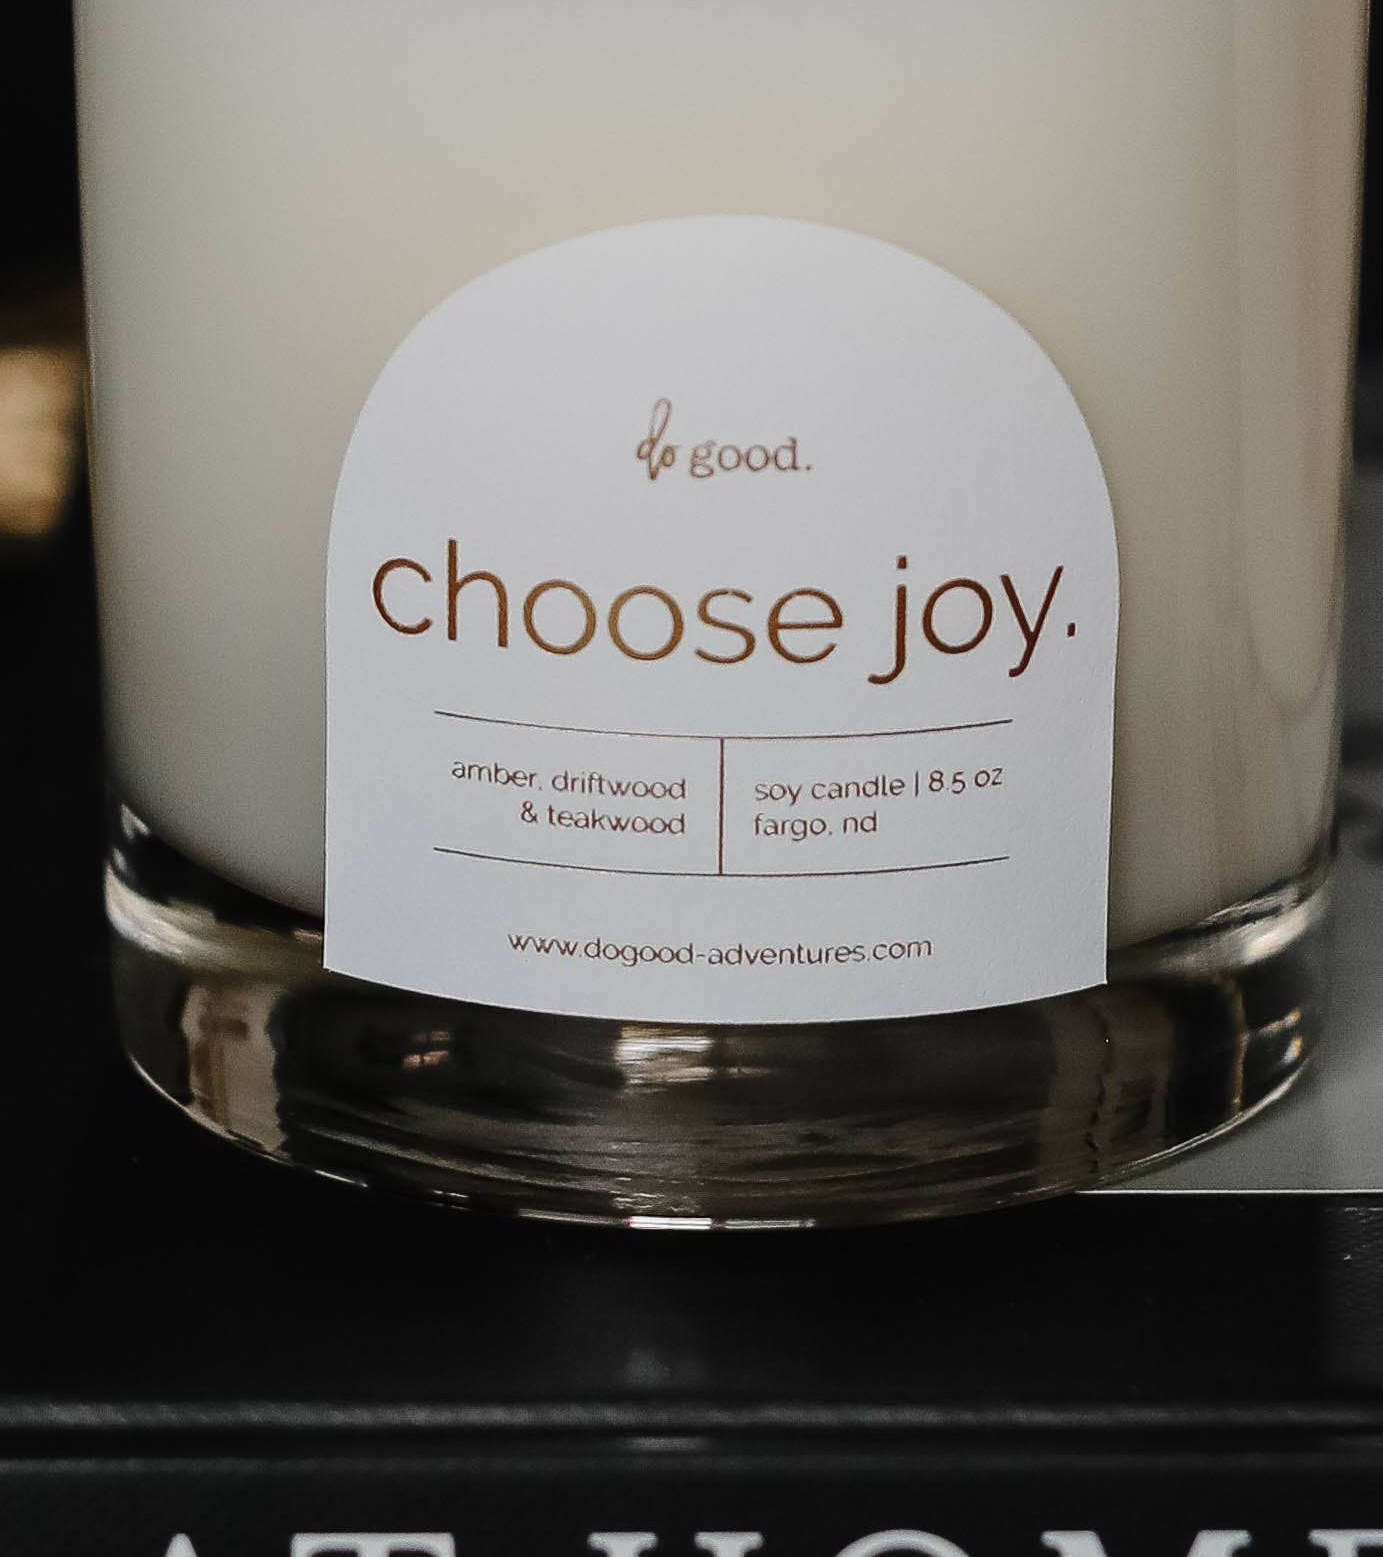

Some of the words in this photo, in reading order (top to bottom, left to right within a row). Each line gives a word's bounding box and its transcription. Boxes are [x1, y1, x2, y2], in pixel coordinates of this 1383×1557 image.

[636, 397, 680, 481] do
[689, 437, 812, 479] good.
[373, 539, 844, 664] choose
[868, 556, 1076, 685] joy.
[551, 771, 686, 800] driftwood
[755, 784, 802, 806] soy
[811, 775, 905, 800] candle
[928, 770, 966, 795] 8.5
[974, 768, 1003, 788] oz
[521, 801, 538, 823] &
[548, 805, 685, 835] teakwood
[843, 811, 877, 833] nd
[508, 935, 932, 967] www.dogood-adventures.com
